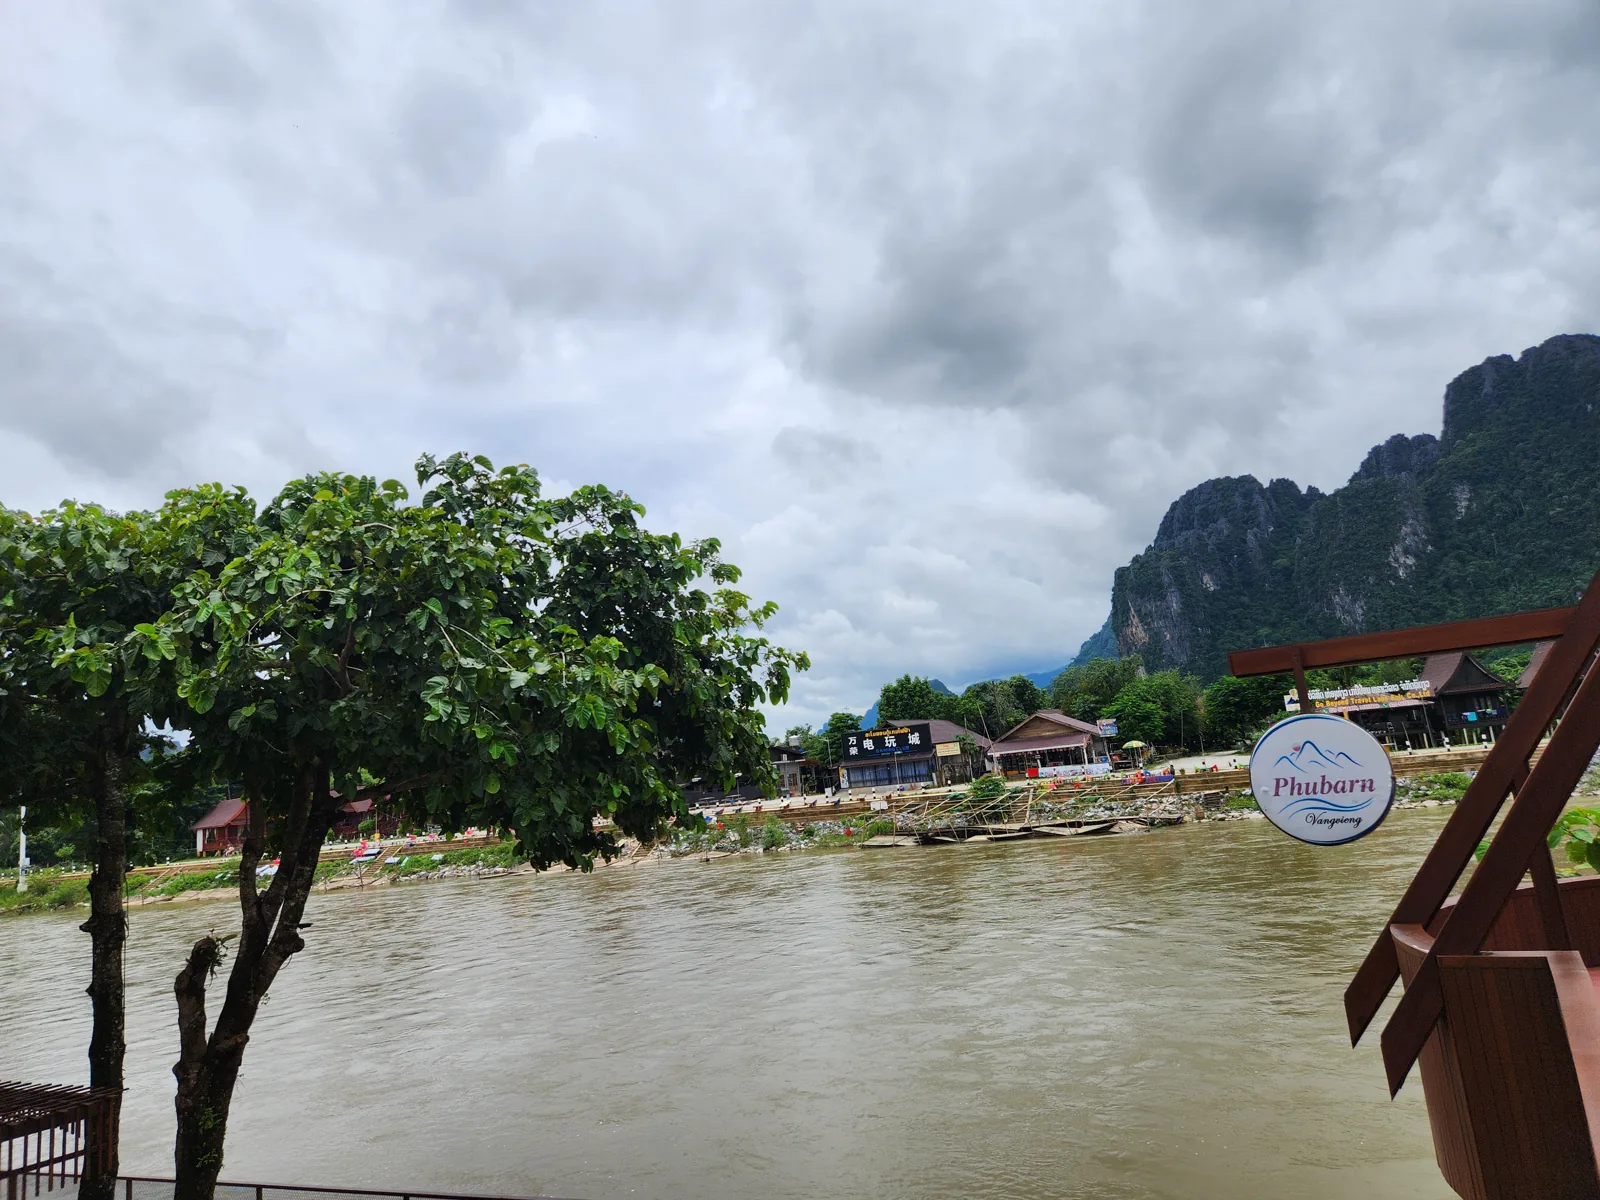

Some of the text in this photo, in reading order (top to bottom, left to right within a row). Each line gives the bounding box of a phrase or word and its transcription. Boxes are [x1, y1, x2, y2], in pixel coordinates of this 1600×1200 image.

[1325, 699, 1349, 707] Beyond
[1351, 697, 1371, 705] Travel
[863, 732, 921, 750] 电玩城
[1272, 775, 1376, 797] Phubarn
[1305, 811, 1363, 829] Vangvieng
